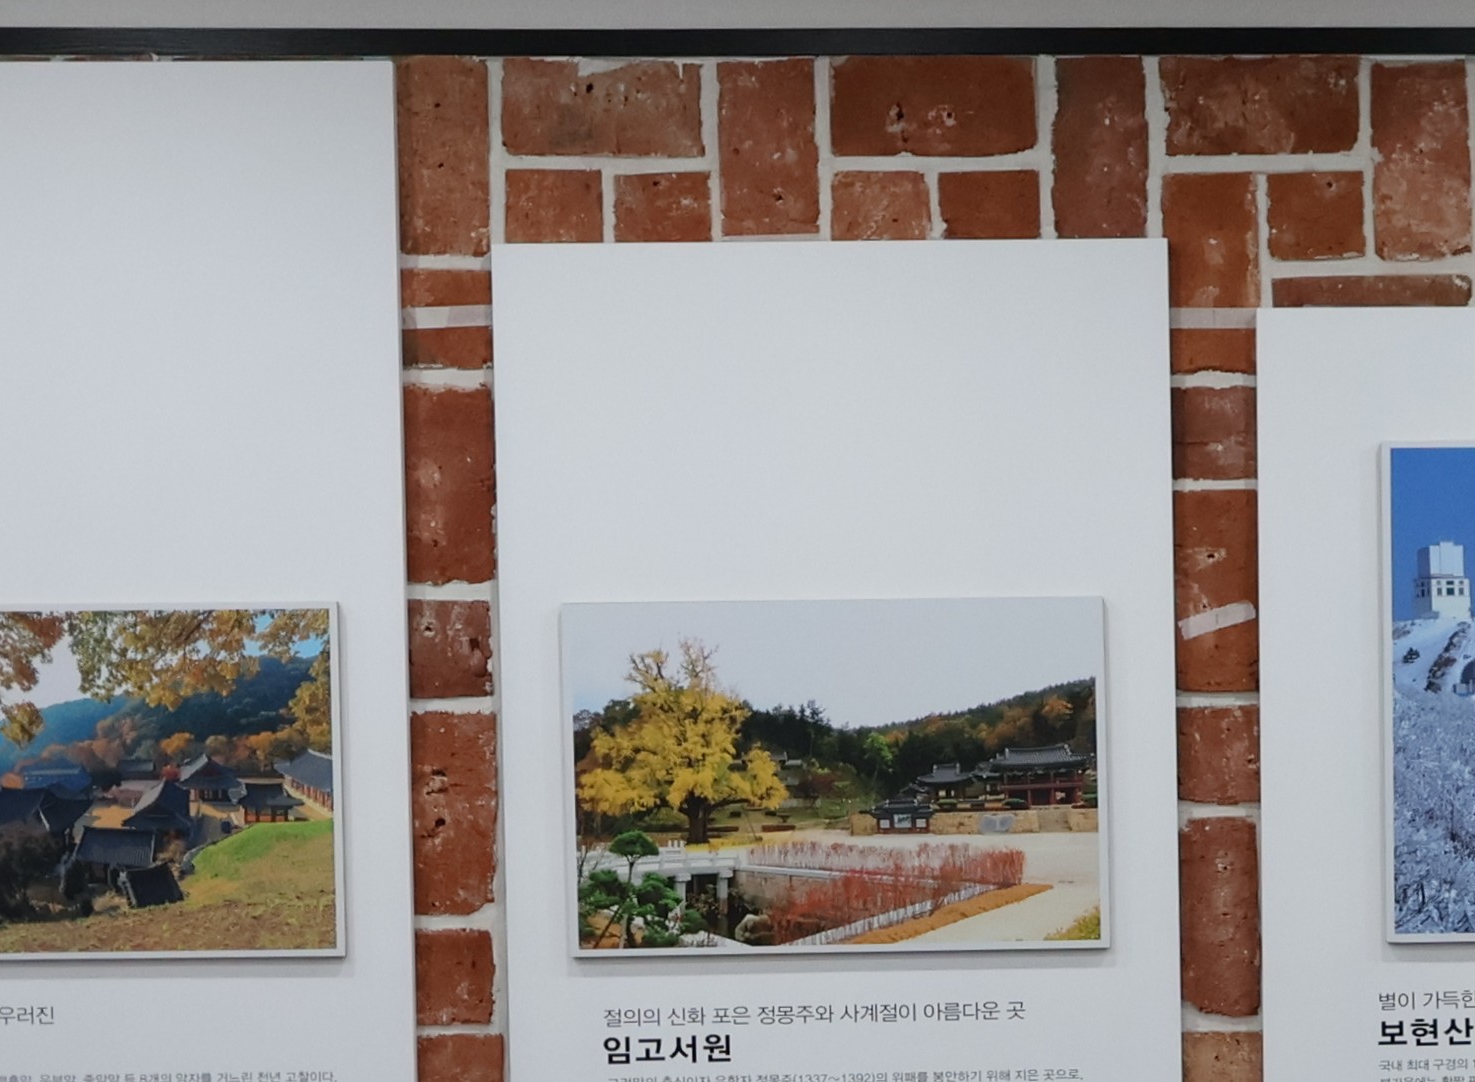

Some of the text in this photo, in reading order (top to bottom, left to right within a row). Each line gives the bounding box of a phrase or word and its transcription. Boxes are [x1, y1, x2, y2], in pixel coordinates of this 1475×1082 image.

[1378, 991, 1416, 1012] 별이
[603, 1000, 1026, 1029] 절의의 신화 포은 정몽주와 사계절이 아름다운 곳
[1378, 1017, 1475, 1048] 보현산
[601, 1033, 733, 1066] 임고서원
[985, 1069, 1012, 1082] 위해
[1014, 1068, 1039, 1082] 지은
[1378, 1059, 1404, 1072] 국내
[1432, 1057, 1469, 1071] 구경의
